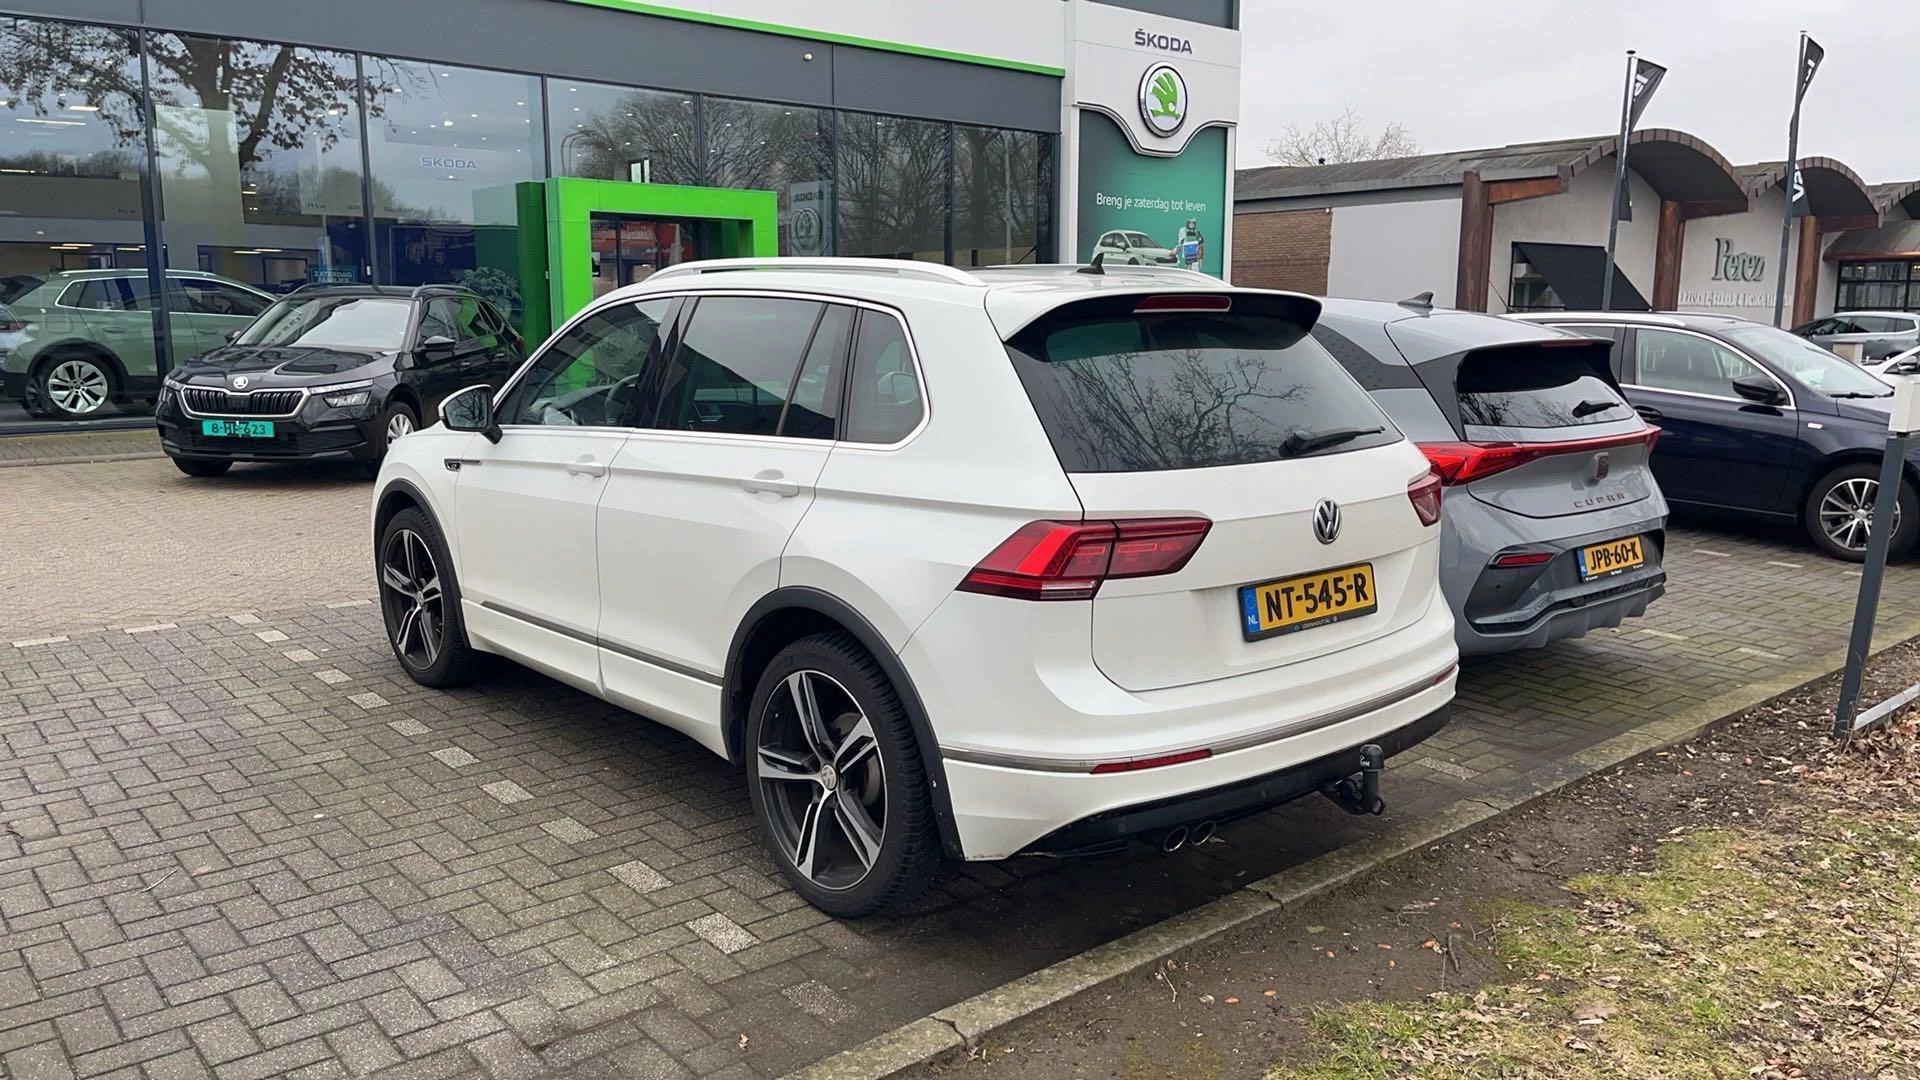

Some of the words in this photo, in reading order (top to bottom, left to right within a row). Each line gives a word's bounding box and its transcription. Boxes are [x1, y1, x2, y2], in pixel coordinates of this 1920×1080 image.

[1135, 28, 1193, 54] ŠKODA
[1096, 192, 1123, 209] Breng
[1124, 196, 1132, 209] je
[1134, 198, 1169, 212] zaterdag
[1171, 200, 1184, 211] tot
[1186, 200, 1206, 211] leven
[1591, 541, 1640, 570] JPB-60-K
[1265, 572, 1369, 623] NT-545-R
